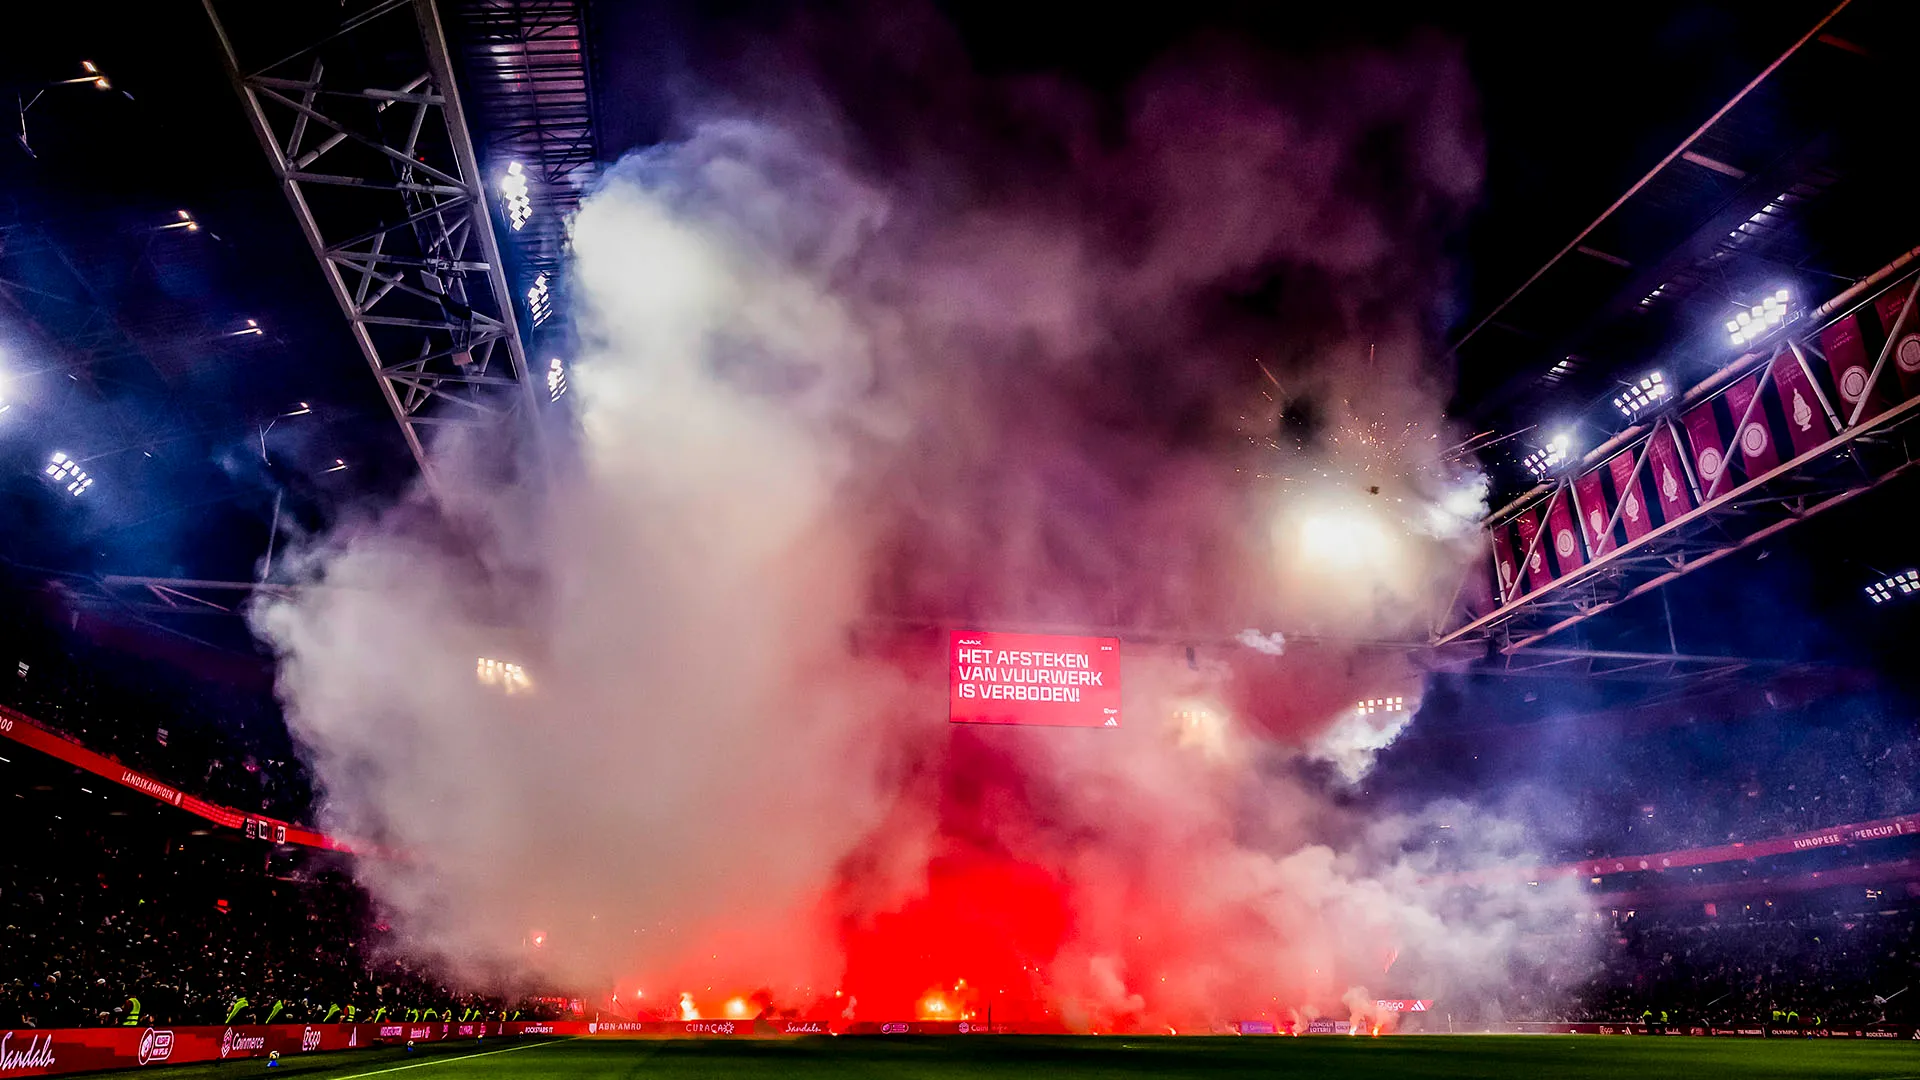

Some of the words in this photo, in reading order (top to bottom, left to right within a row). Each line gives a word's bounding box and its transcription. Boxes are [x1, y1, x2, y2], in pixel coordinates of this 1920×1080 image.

[958, 648, 993, 665] HET
[997, 650, 1089, 669] AFSTEKEN
[958, 666, 997, 682] VAN
[1001, 667, 1103, 687] VUURWERK
[958, 683, 976, 699] IS
[979, 685, 1081, 703] VERBODEN!
[121, 770, 175, 801] LANDSKAMPIOEN
[1793, 834, 1840, 849] EUROPESE
[0, 1031, 55, 1071] Sandals
